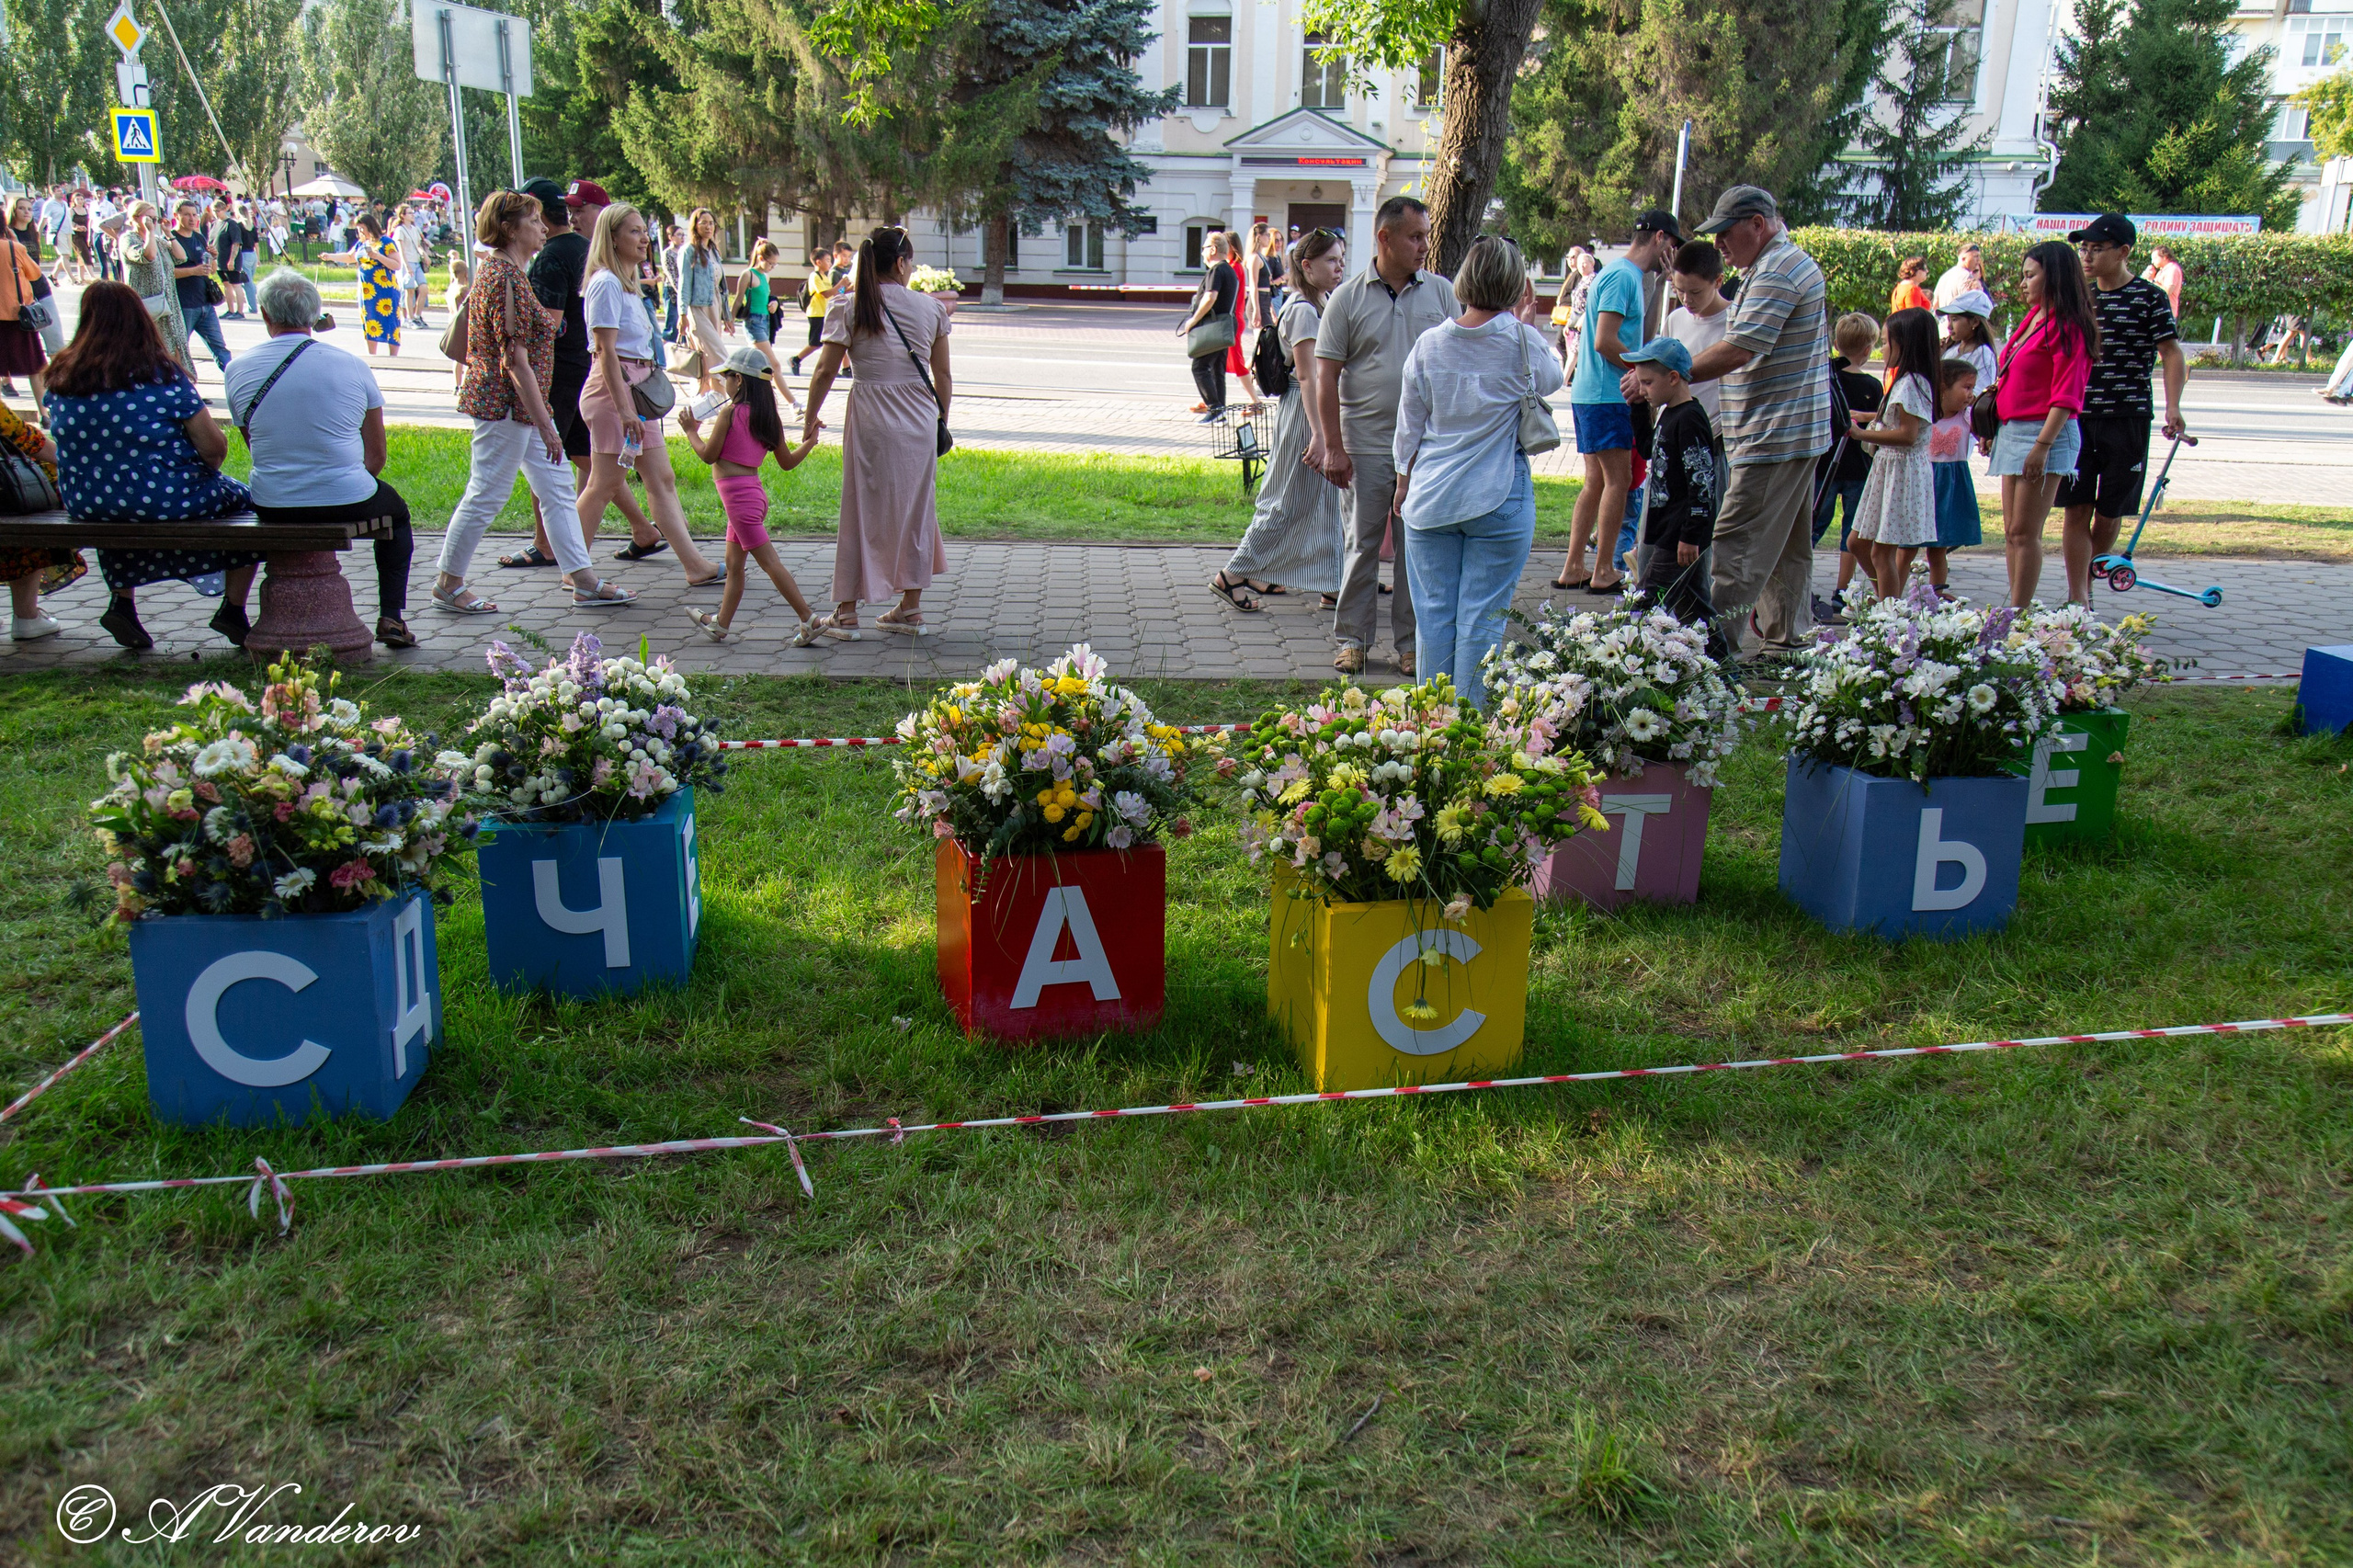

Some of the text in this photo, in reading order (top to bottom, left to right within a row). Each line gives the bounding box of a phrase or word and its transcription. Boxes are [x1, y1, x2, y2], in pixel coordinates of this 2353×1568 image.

[1298, 157, 1362, 165] Консультации
[2036, 220, 2066, 230] НАША
[2144, 222, 2188, 233] РОДИНУ
[254, 379, 275, 404] FEATHER
[1600, 794, 1672, 891] Т
[1912, 808, 1987, 912] Ь
[532, 857, 631, 968] Ч
[1009, 885, 1122, 1009] А
[186, 950, 332, 1087] С
[392, 896, 433, 1080] Д
[1368, 928, 1487, 1055] С
